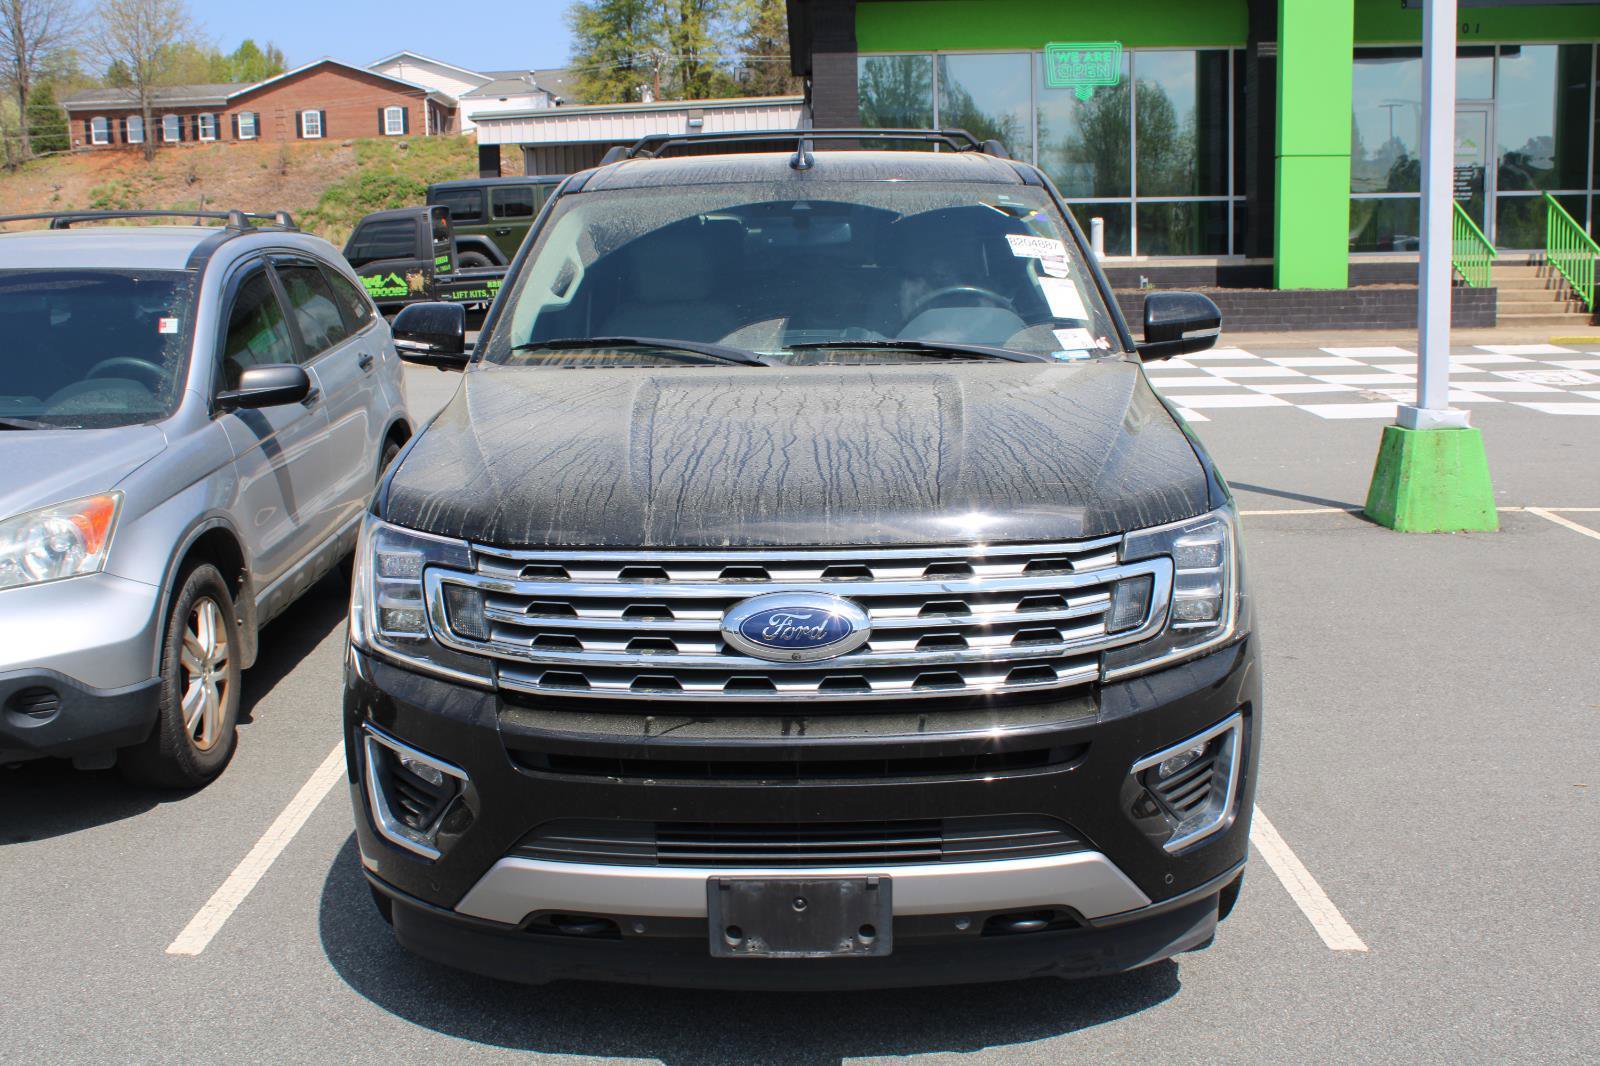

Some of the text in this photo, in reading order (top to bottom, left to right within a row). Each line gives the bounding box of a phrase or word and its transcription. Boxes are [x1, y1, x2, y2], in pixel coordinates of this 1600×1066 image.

[1056, 51, 1111, 62] WE ARE
[1057, 63, 1111, 79] OPEN
[452, 291, 468, 299] LIFT
[762, 613, 828, 640] Ford
